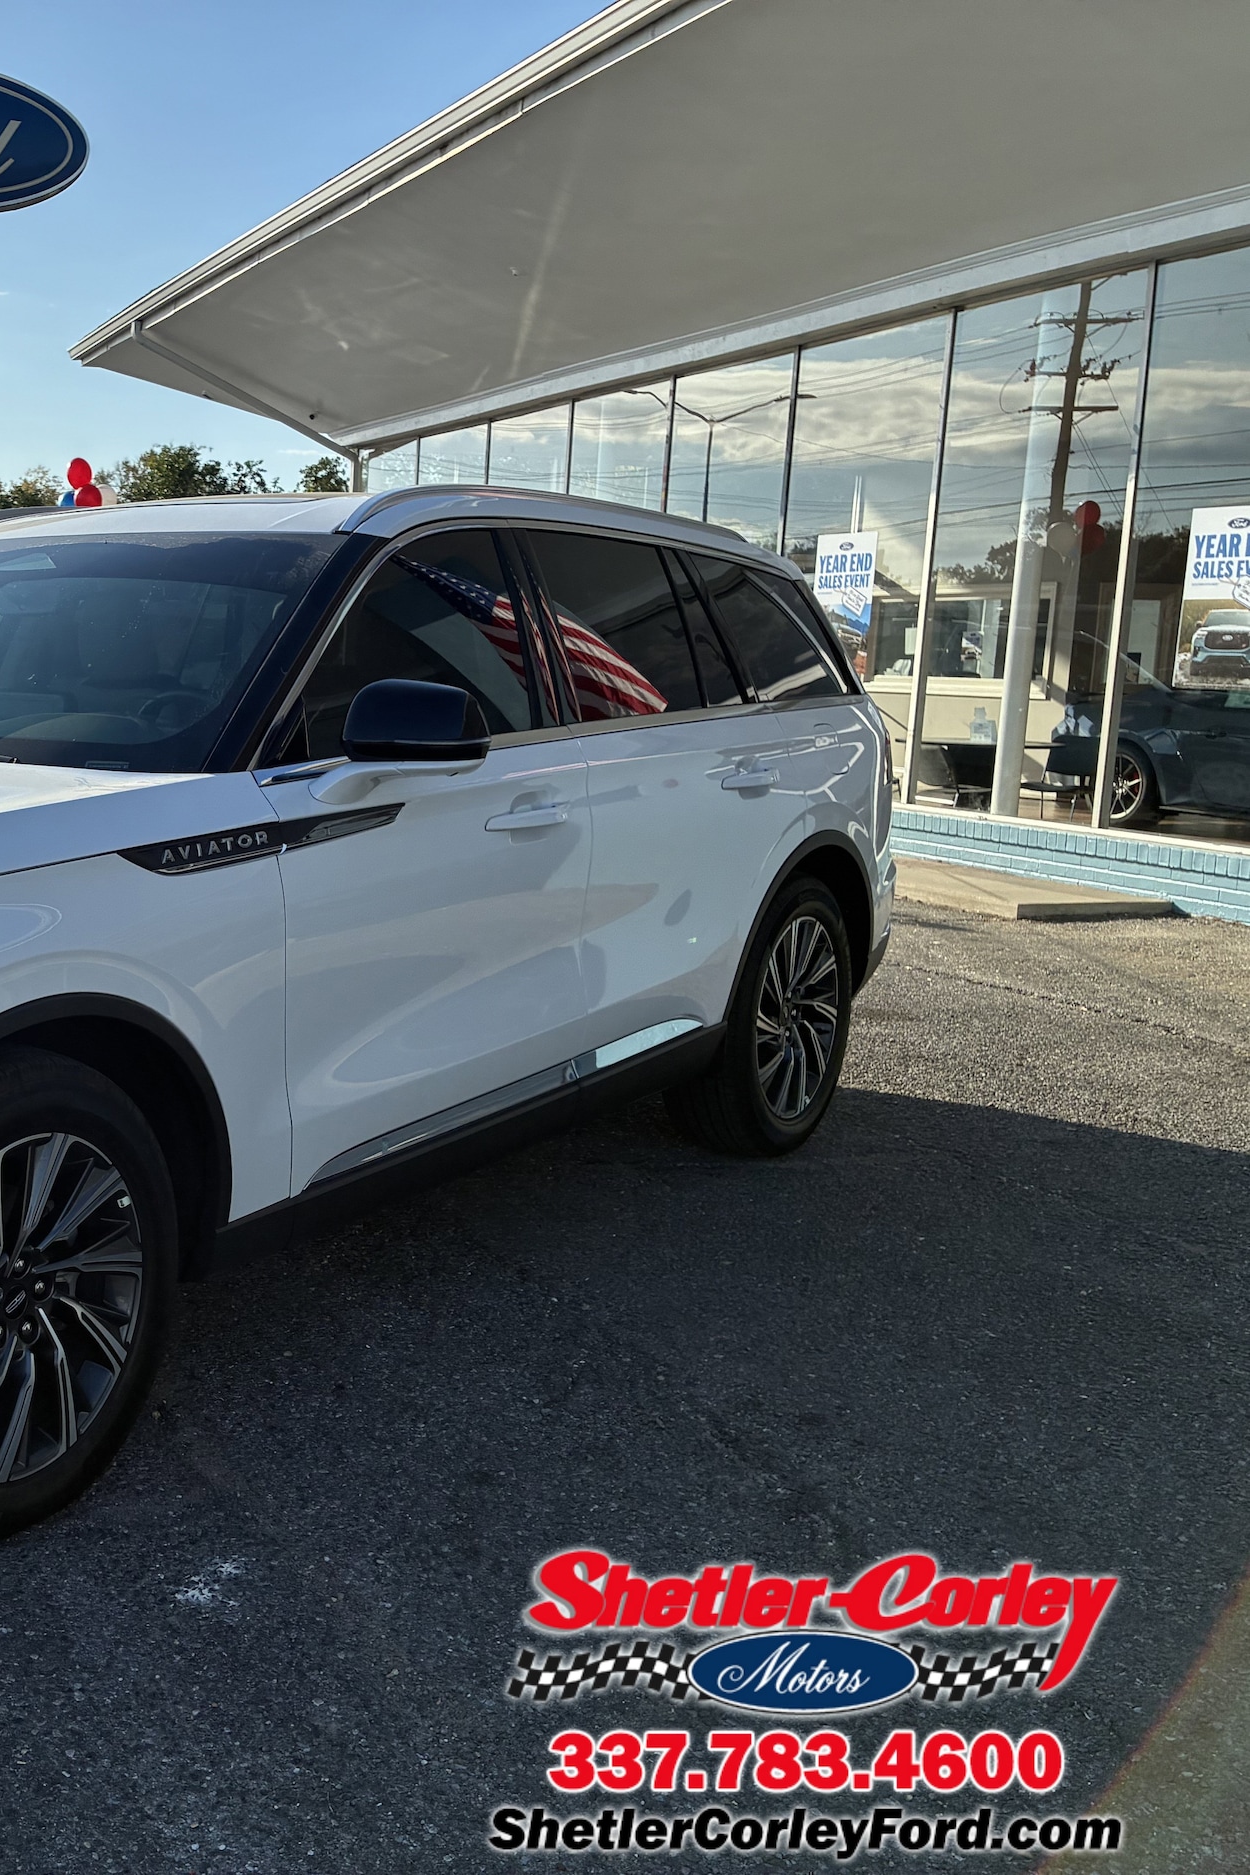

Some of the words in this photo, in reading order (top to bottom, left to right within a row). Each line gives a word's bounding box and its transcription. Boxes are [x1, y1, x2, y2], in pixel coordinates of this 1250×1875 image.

[1195, 533, 1242, 559] YEAR
[819, 554, 848, 574] YEAR
[849, 552, 873, 573] END
[1193, 560, 1234, 579] SALES
[818, 575, 843, 590] SALES
[844, 573, 871, 589] EVENT
[161, 831, 269, 864] AVIATOR
